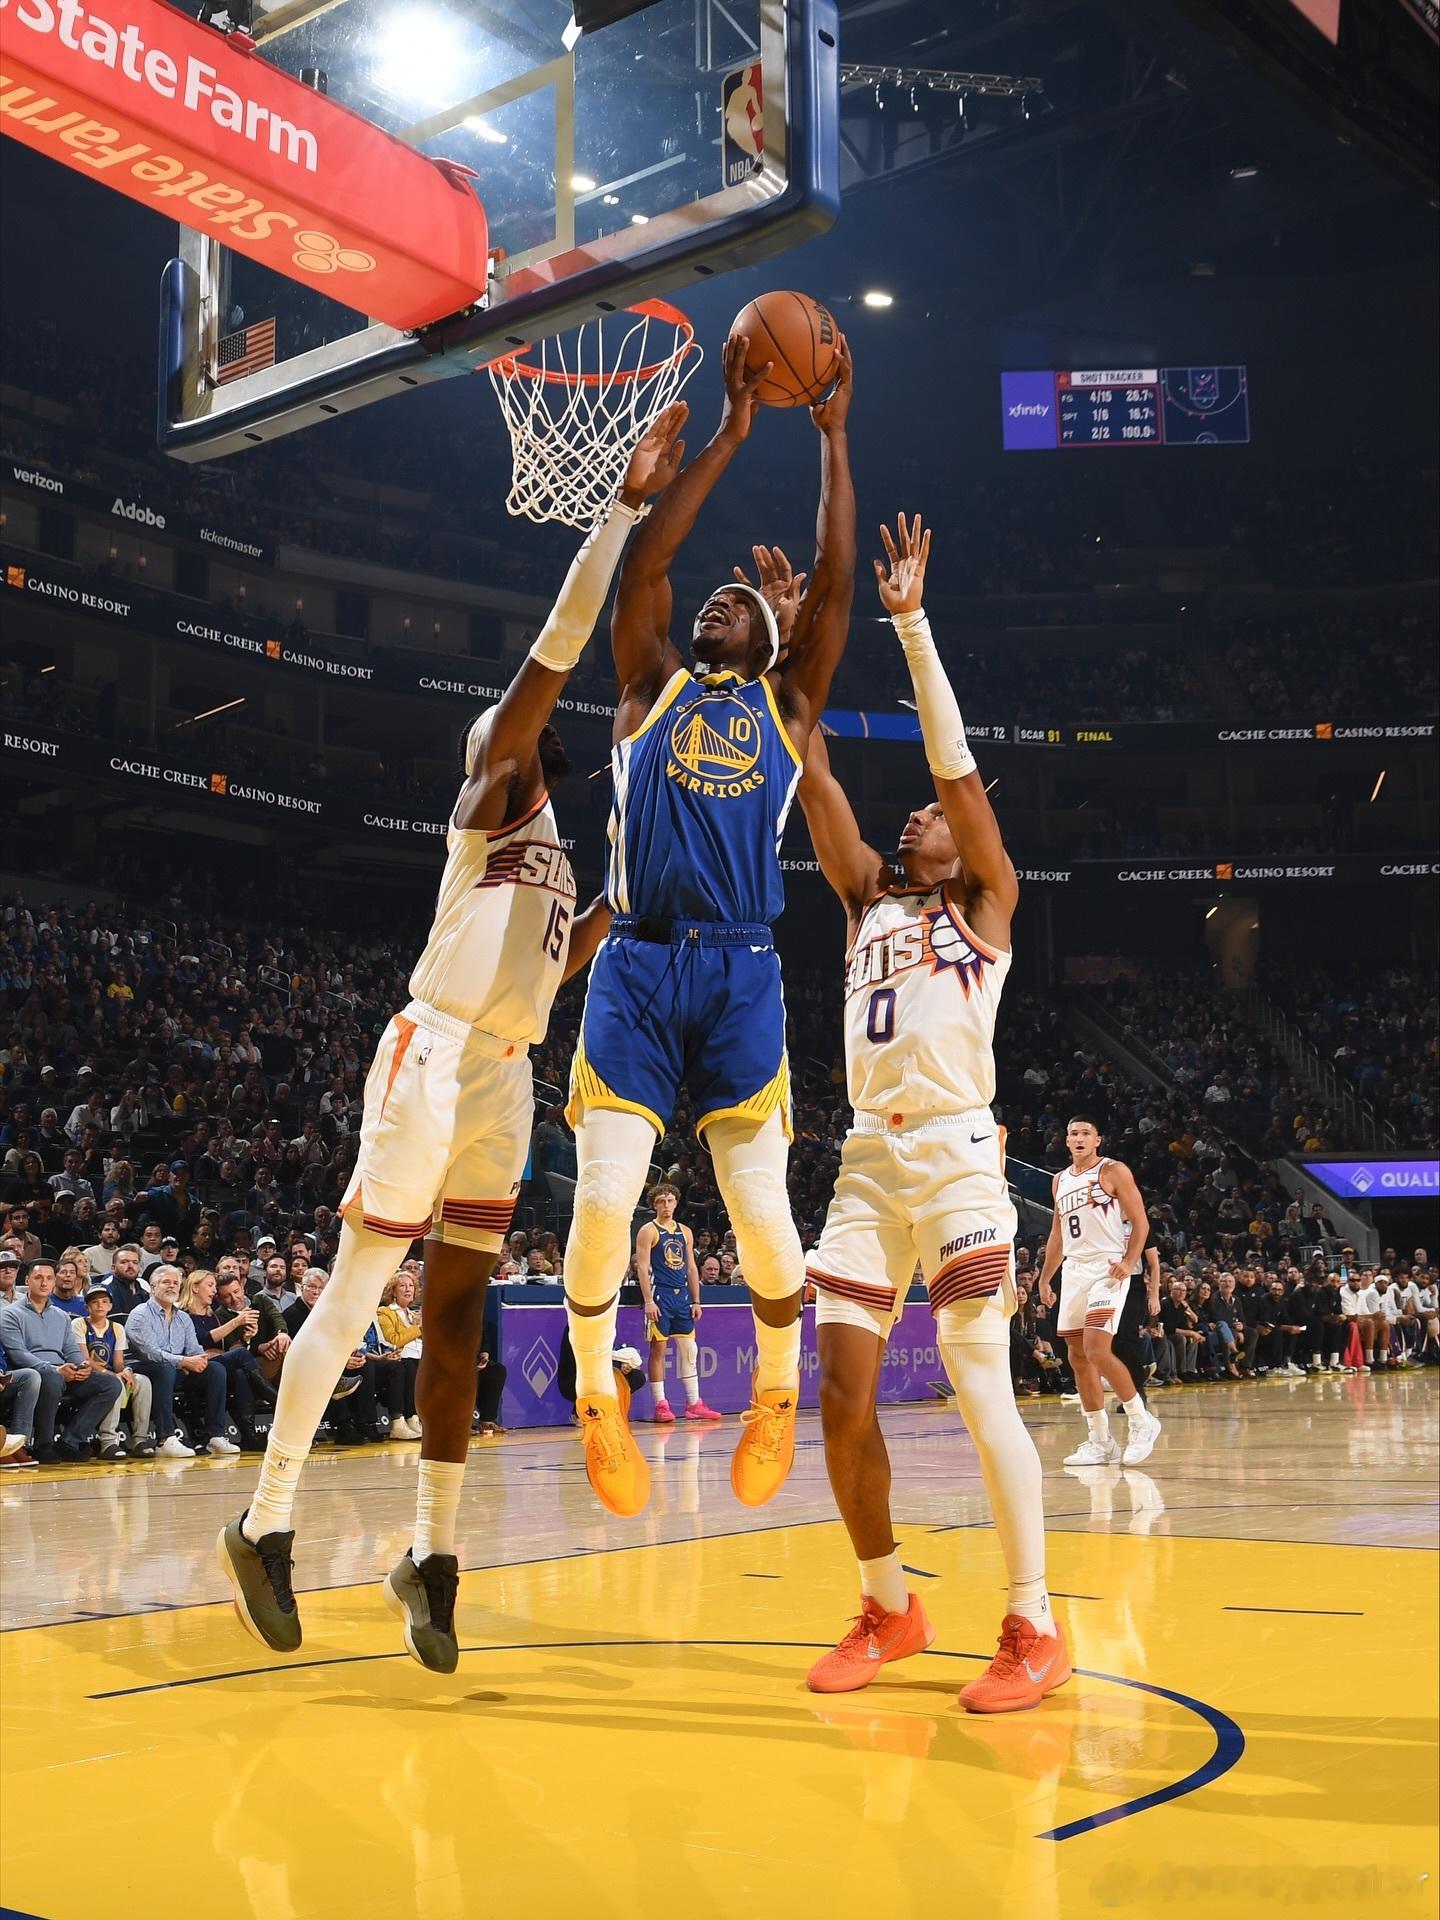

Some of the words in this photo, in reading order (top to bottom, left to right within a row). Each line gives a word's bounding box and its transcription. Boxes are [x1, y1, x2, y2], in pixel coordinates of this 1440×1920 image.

[730, 158, 751, 183] NBA
[1080, 373, 1102, 384] SHOT
[1105, 371, 1144, 383] TRACKER
[1089, 389, 1112, 404] 4/15
[1009, 403, 1049, 418] xfinity
[1091, 408, 1110, 422] 1/6
[1090, 426, 1111, 441] 2/2
[13, 467, 64, 494] verizon
[111, 498, 166, 530] Adobe
[200, 528, 263, 558] ticketmaster
[27, 578, 79, 602] CASINO
[81, 592, 131, 617] RESORT
[176, 620, 222, 642] CACHE
[223, 634, 264, 654] CREEK
[282, 650, 325, 671] CASINO
[326, 662, 374, 680] RESORT
[418, 677, 466, 694] CACHE
[728, 716, 751, 742] 10
[992, 726, 1006, 740] 72
[1020, 729, 1045, 740] SCAR
[1076, 731, 1113, 742] FINAL
[1217, 729, 1267, 741] CACHE
[1268, 728, 1313, 740] CREEK
[1334, 726, 1384, 738] CASINO
[1385, 725, 1435, 737] RESORT
[3, 733, 60, 757] RESORT
[110, 757, 161, 779] CACHE
[163, 769, 208, 790] CREEK
[229, 784, 275, 804] CASINO
[277, 795, 322, 814] RESORT
[665, 759, 765, 798] WARRIORS
[363, 814, 409, 831] CACHE
[411, 821, 447, 835] CREE
[1025, 869, 1072, 882] RESORT
[1117, 869, 1167, 881] CACHE
[1168, 868, 1213, 880] CREEK
[1234, 867, 1285, 879] CASINO
[1286, 866, 1335, 878] RESORT
[1379, 864, 1429, 875] CACHE
[542, 898, 569, 962] 15
[866, 988, 897, 1044] 0
[1068, 1215, 1082, 1239] 8
[940, 1227, 998, 1262] PHOENIX
